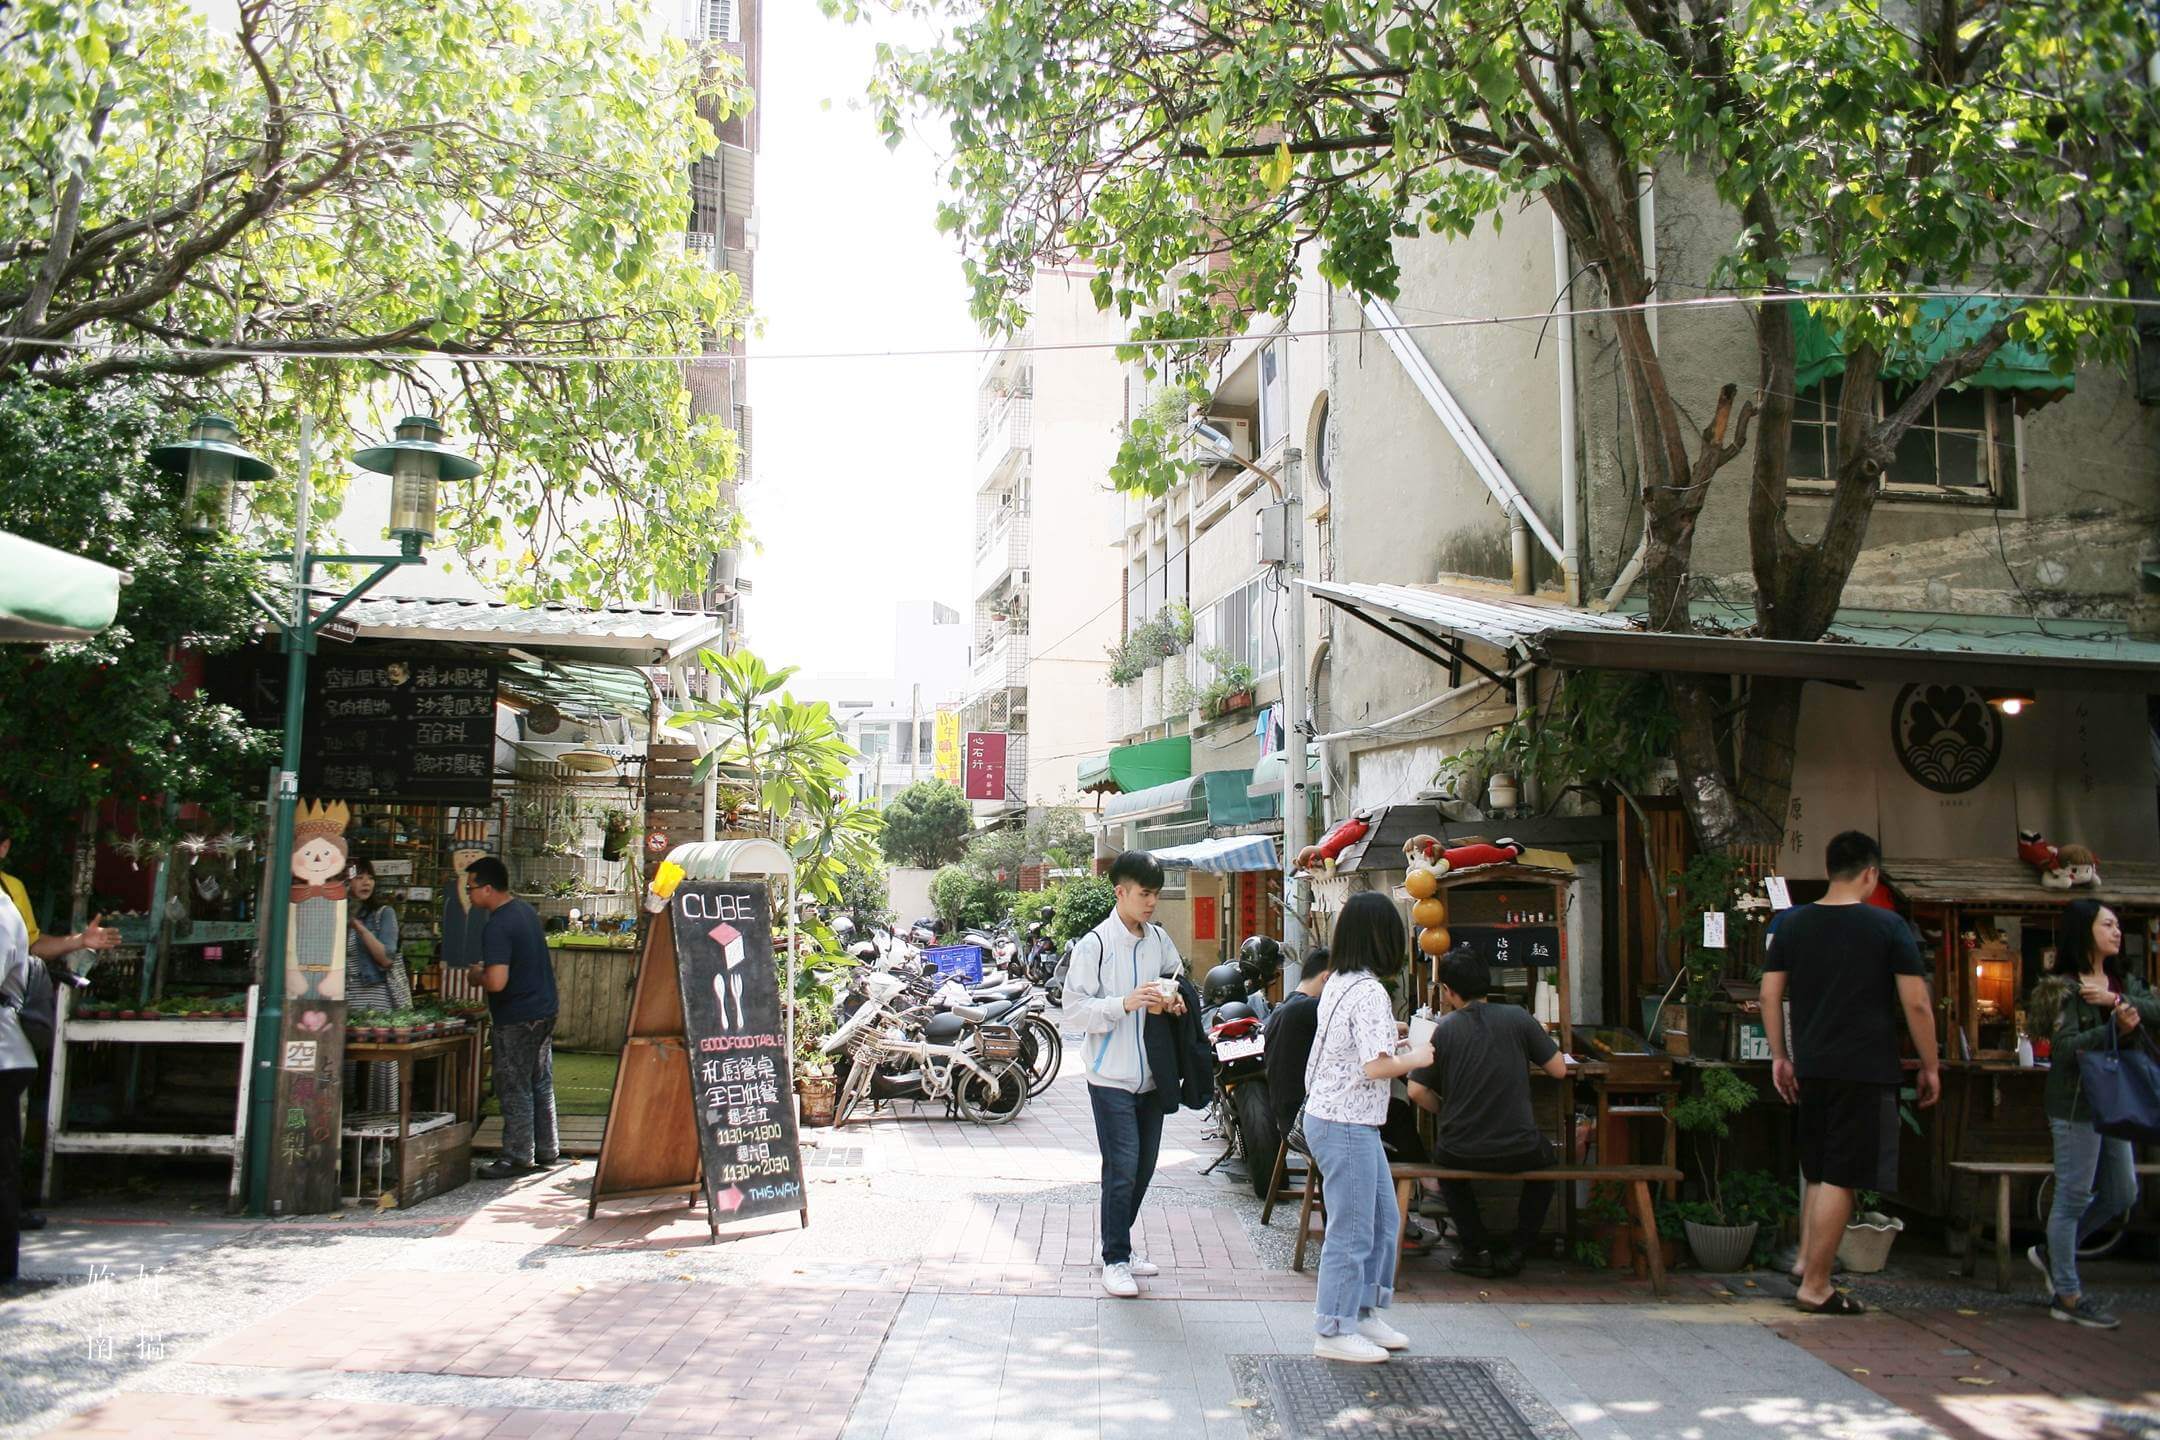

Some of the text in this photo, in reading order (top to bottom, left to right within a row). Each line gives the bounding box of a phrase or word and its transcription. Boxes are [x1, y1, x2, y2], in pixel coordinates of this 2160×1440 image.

[416, 721, 468, 744] 百合科
[681, 893, 755, 921] CUBE
[702, 1055, 777, 1083] 私廚餐桌
[705, 1079, 780, 1107] 全日供餐
[736, 1142, 770, 1162] 週六日
